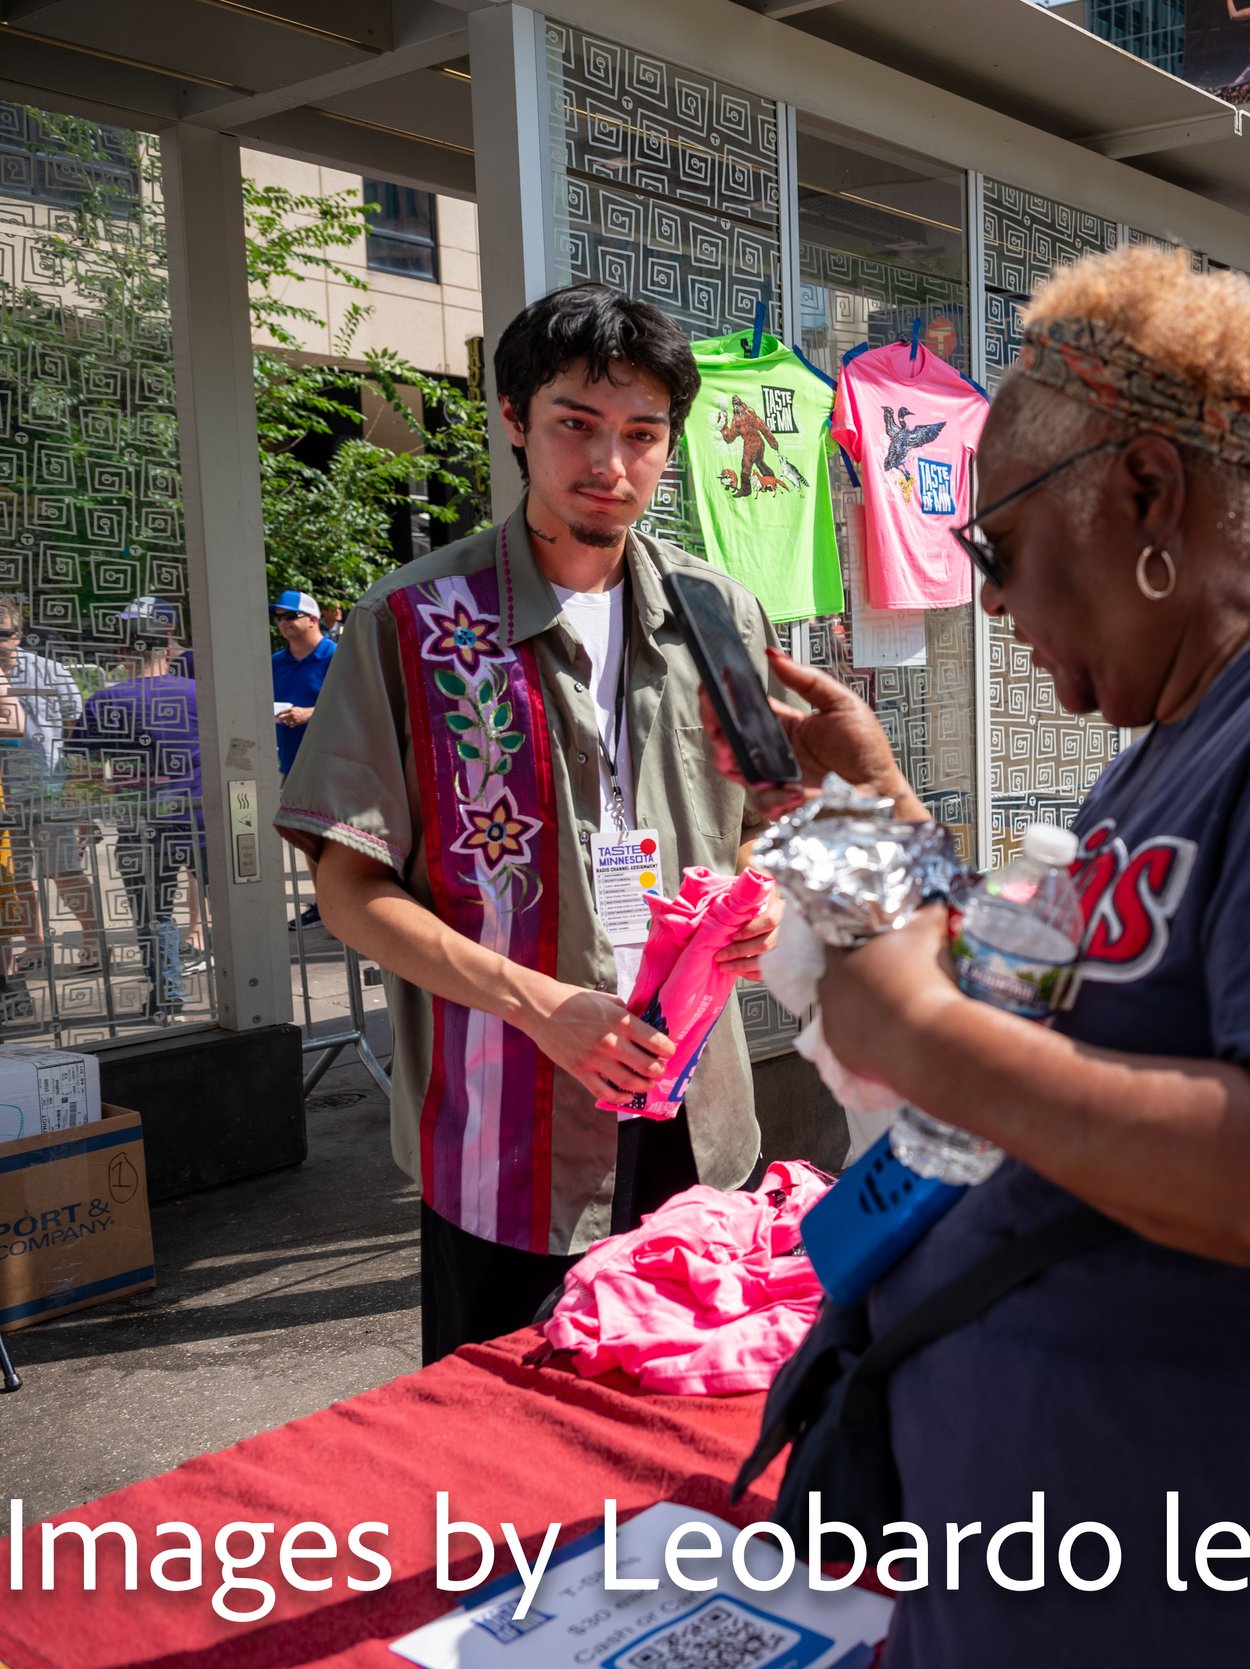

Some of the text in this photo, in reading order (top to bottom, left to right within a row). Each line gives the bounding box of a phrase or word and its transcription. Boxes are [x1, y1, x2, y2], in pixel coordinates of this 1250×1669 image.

[762, 387, 792, 418] TASTE
[919, 461, 950, 496] TASTE
[598, 844, 642, 857] TASTE
[599, 854, 654, 867] MINNESOTA
[88, 1198, 111, 1218] &
